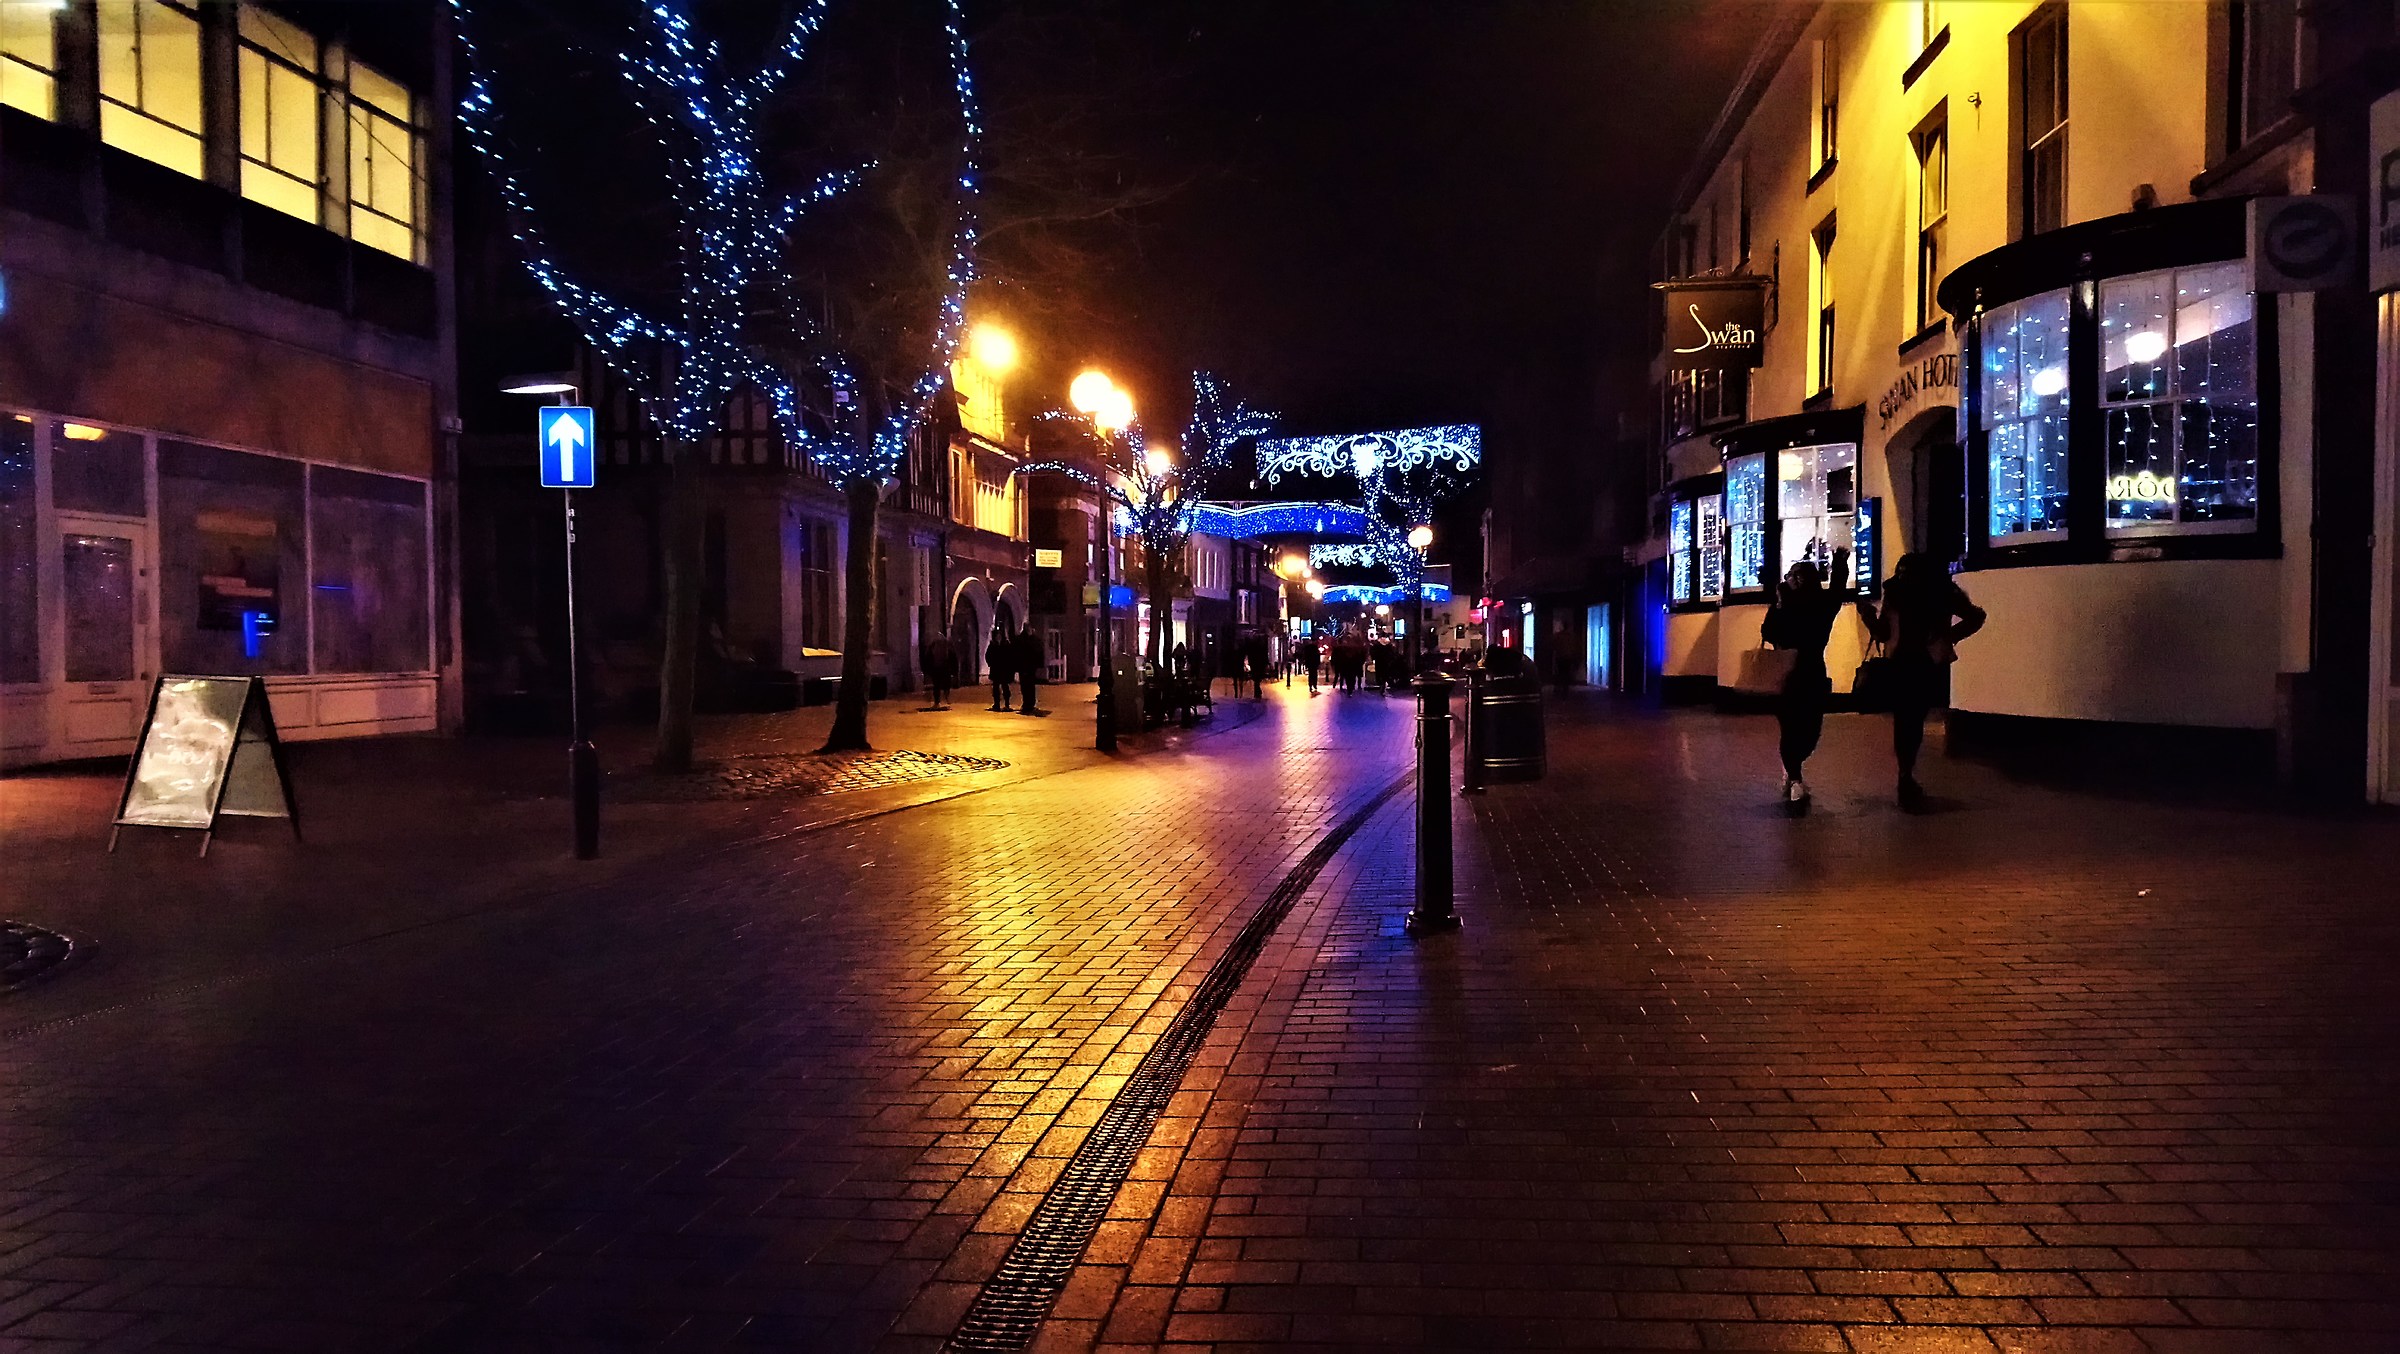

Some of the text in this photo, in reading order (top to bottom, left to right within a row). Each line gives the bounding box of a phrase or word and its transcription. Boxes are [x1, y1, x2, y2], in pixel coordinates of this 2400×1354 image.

[1673, 303, 1755, 354] Swan
[1725, 321, 1741, 331] the
[1878, 366, 1919, 430] SWAN
